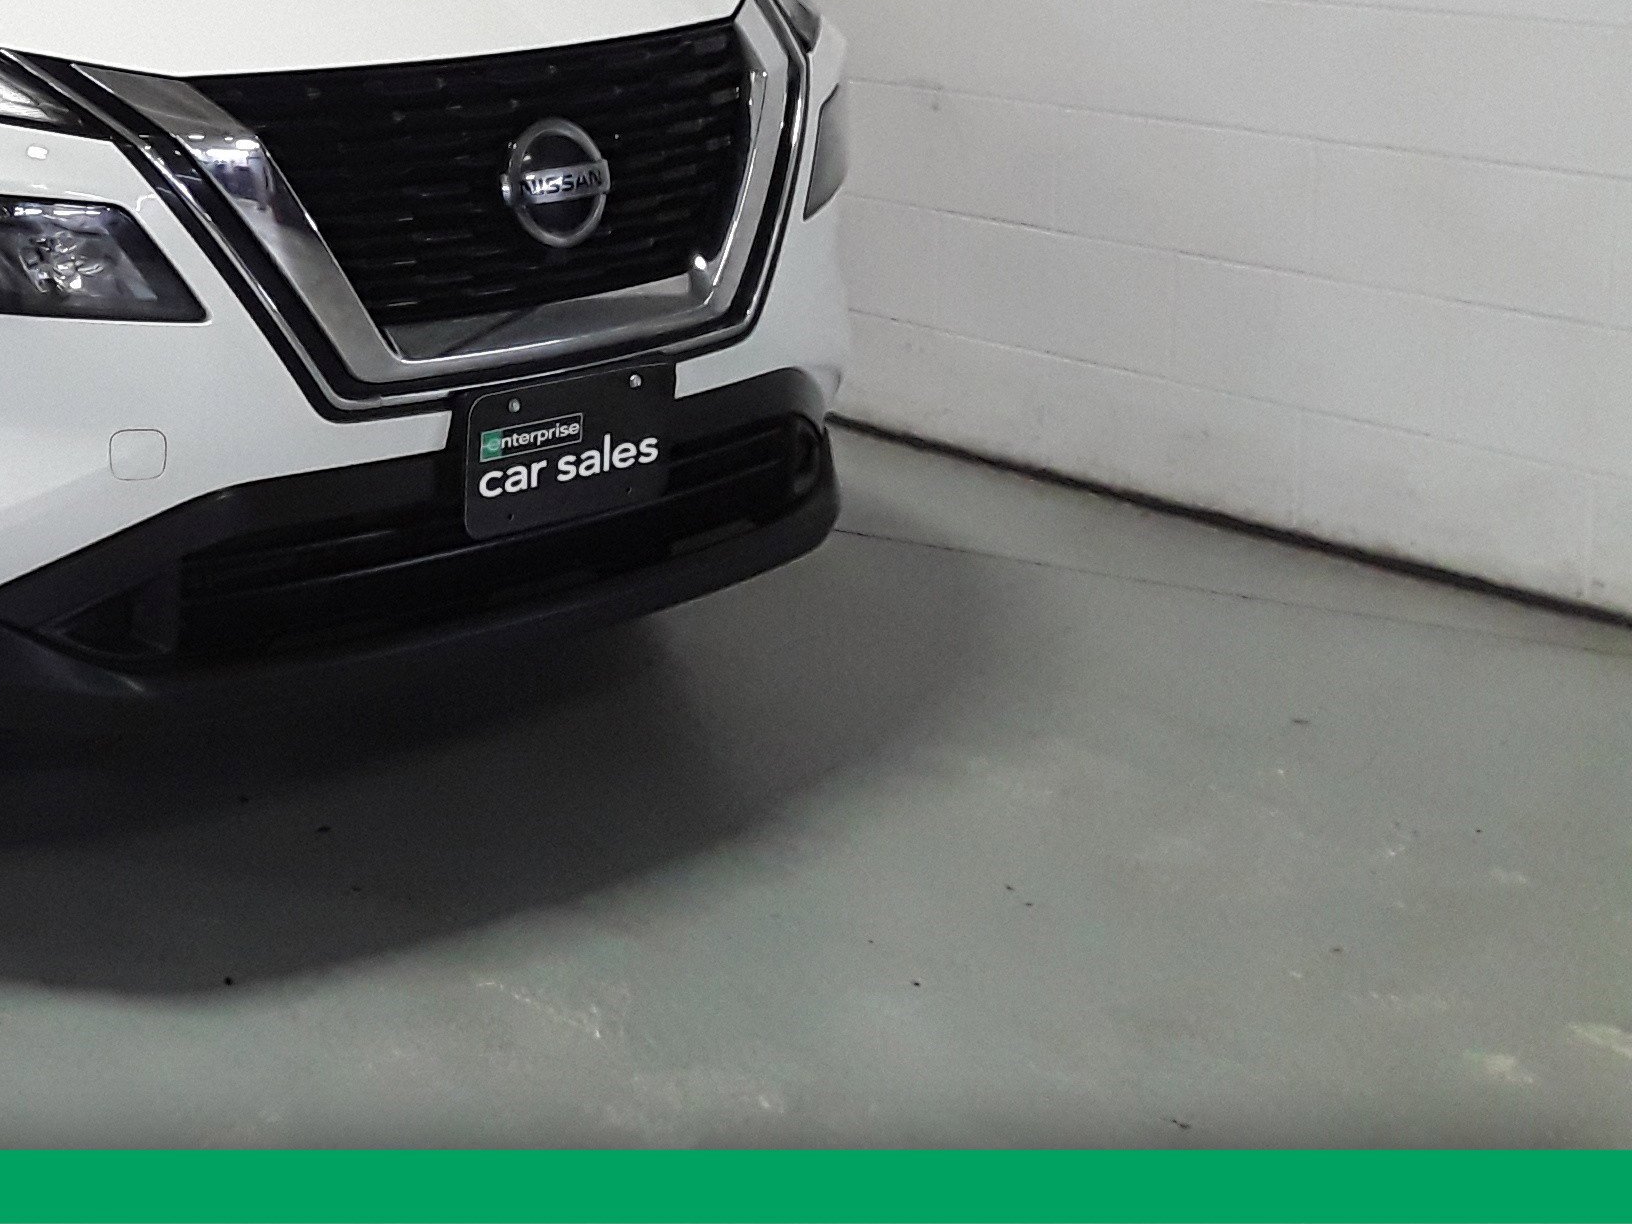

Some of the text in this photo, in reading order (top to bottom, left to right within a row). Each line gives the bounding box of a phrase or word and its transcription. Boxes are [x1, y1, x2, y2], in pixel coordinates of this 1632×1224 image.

[519, 168, 603, 196] NISSAN
[484, 422, 581, 452] enterprise
[479, 433, 660, 498] car sales
